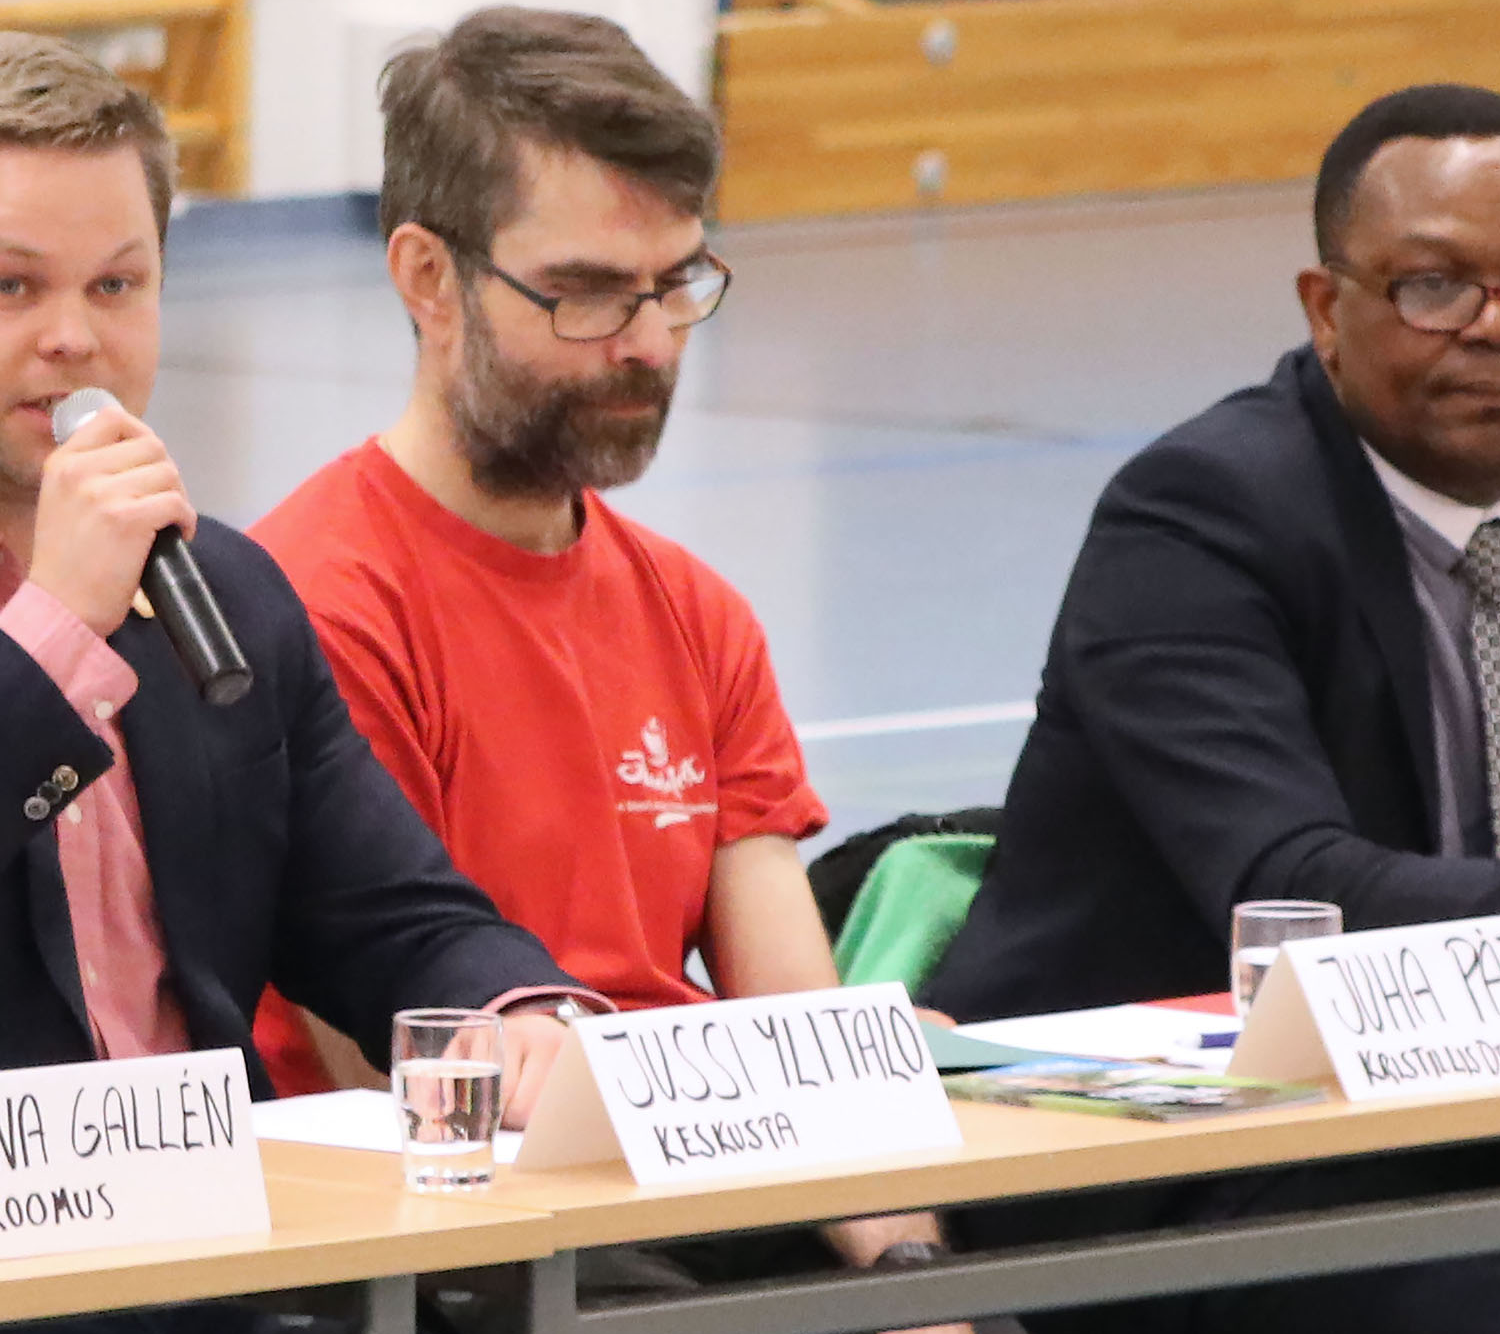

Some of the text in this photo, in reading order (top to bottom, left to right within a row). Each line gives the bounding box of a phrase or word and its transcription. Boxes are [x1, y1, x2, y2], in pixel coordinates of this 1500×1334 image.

[1317, 946, 1447, 1036] JUHA
[602, 1004, 925, 1108] JUSSI YLITALO
[71, 1069, 234, 1158] GALLÉN
[653, 1111, 799, 1166] KESKUSTA
